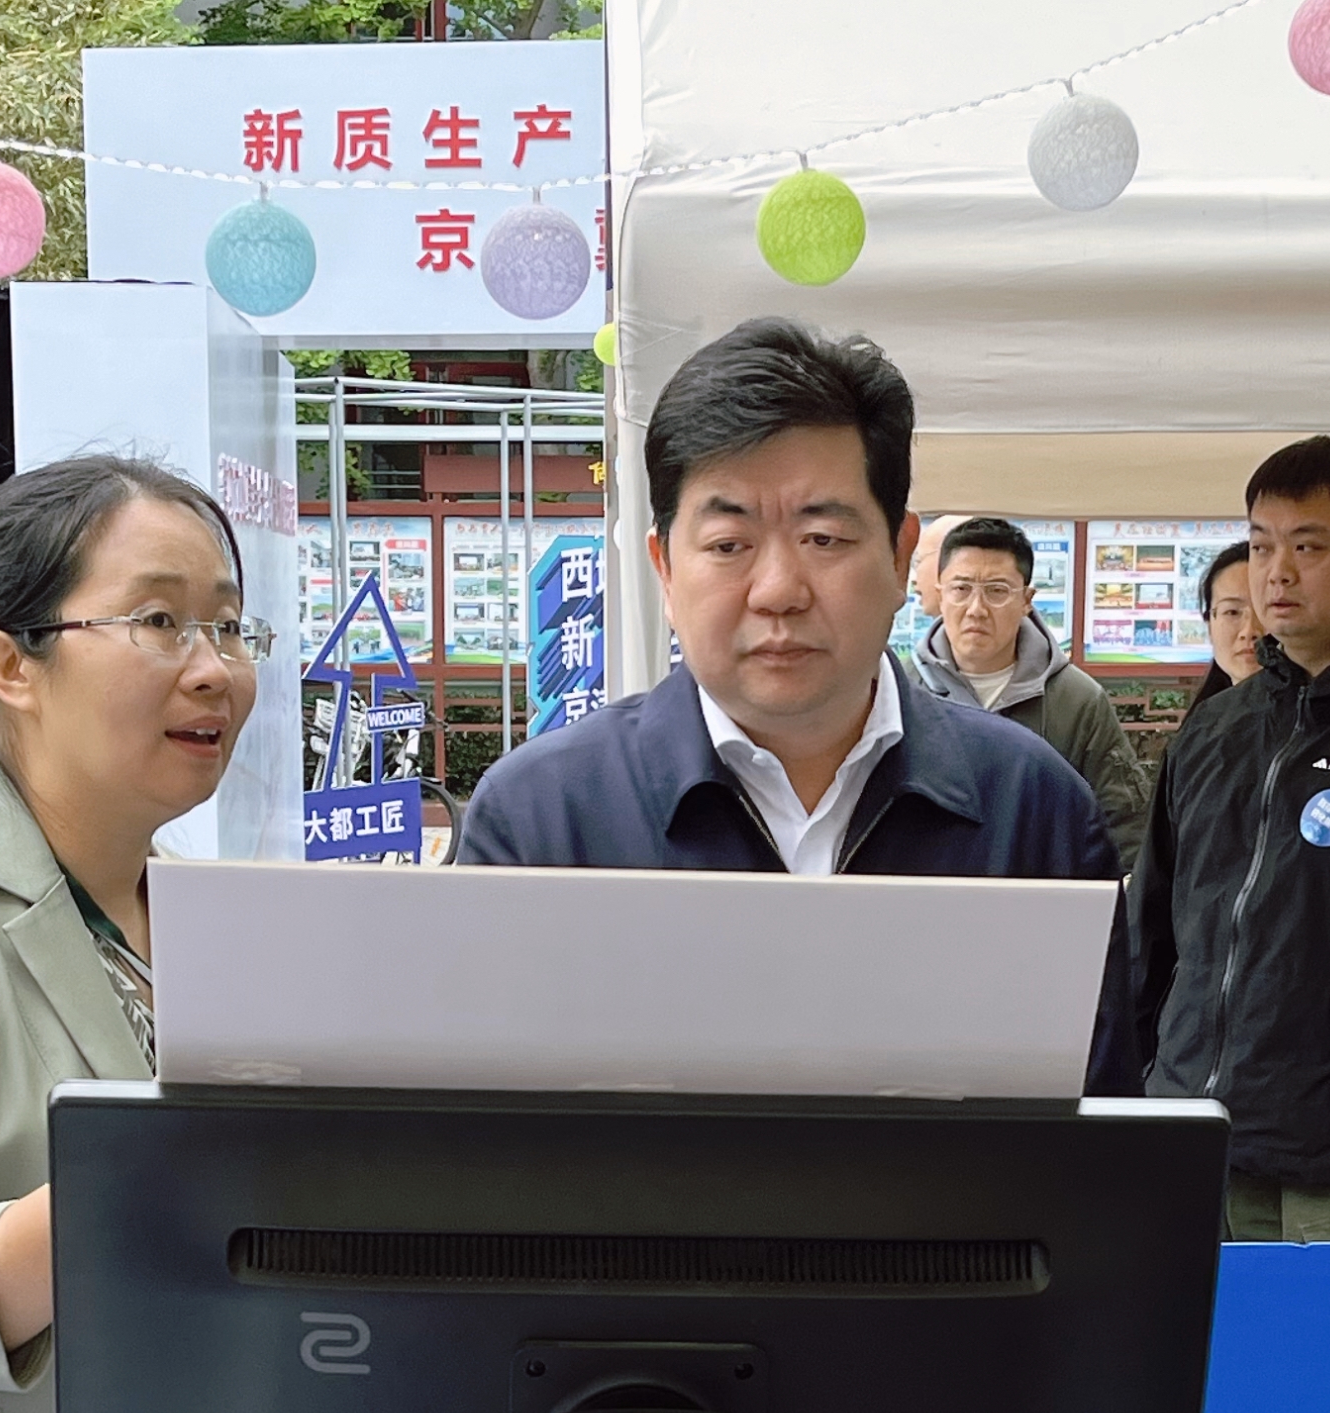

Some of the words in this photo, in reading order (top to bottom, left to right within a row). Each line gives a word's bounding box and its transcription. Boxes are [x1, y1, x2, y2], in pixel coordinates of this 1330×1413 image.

[243, 103, 572, 174] 新质生产
[368, 706, 423, 729] WELCOME
[304, 800, 405, 846] 大都工匠
